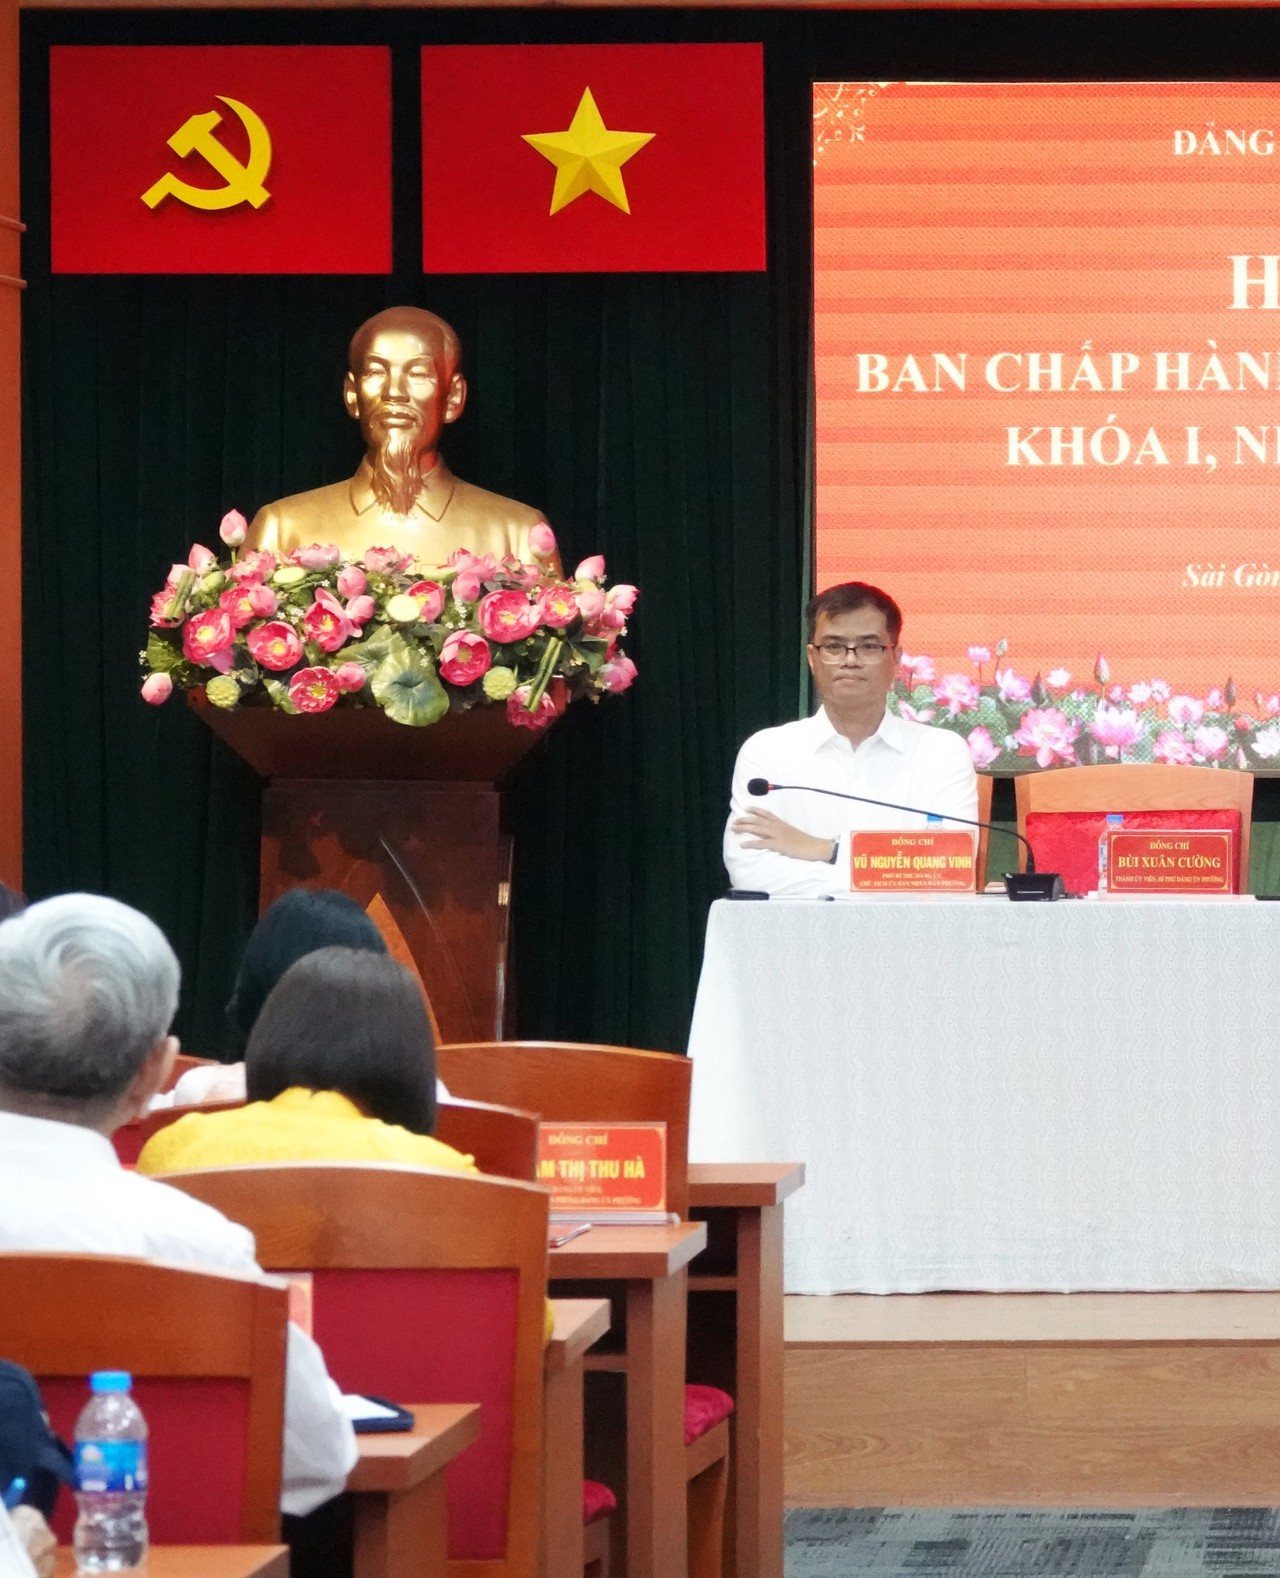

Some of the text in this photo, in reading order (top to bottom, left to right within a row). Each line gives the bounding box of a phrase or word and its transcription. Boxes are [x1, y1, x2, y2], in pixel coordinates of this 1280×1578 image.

[1173, 121, 1275, 156] ĐẢNG
[855, 352, 970, 393] BAN
[984, 339, 1140, 392] CHẤP
[1003, 413, 1171, 467] KHÓA
[1184, 425, 1218, 474] I,
[1182, 562, 1226, 589] Sài
[1174, 840, 1190, 850] CHÍ
[853, 850, 972, 870] VŨ NGUYỄN QUANG VINH
[1118, 853, 1221, 869] BÙI XUÂN CƯỜNG
[558, 1159, 585, 1182] THỊ
[588, 1159, 620, 1179] THU
[623, 1155, 646, 1179] HÀ
